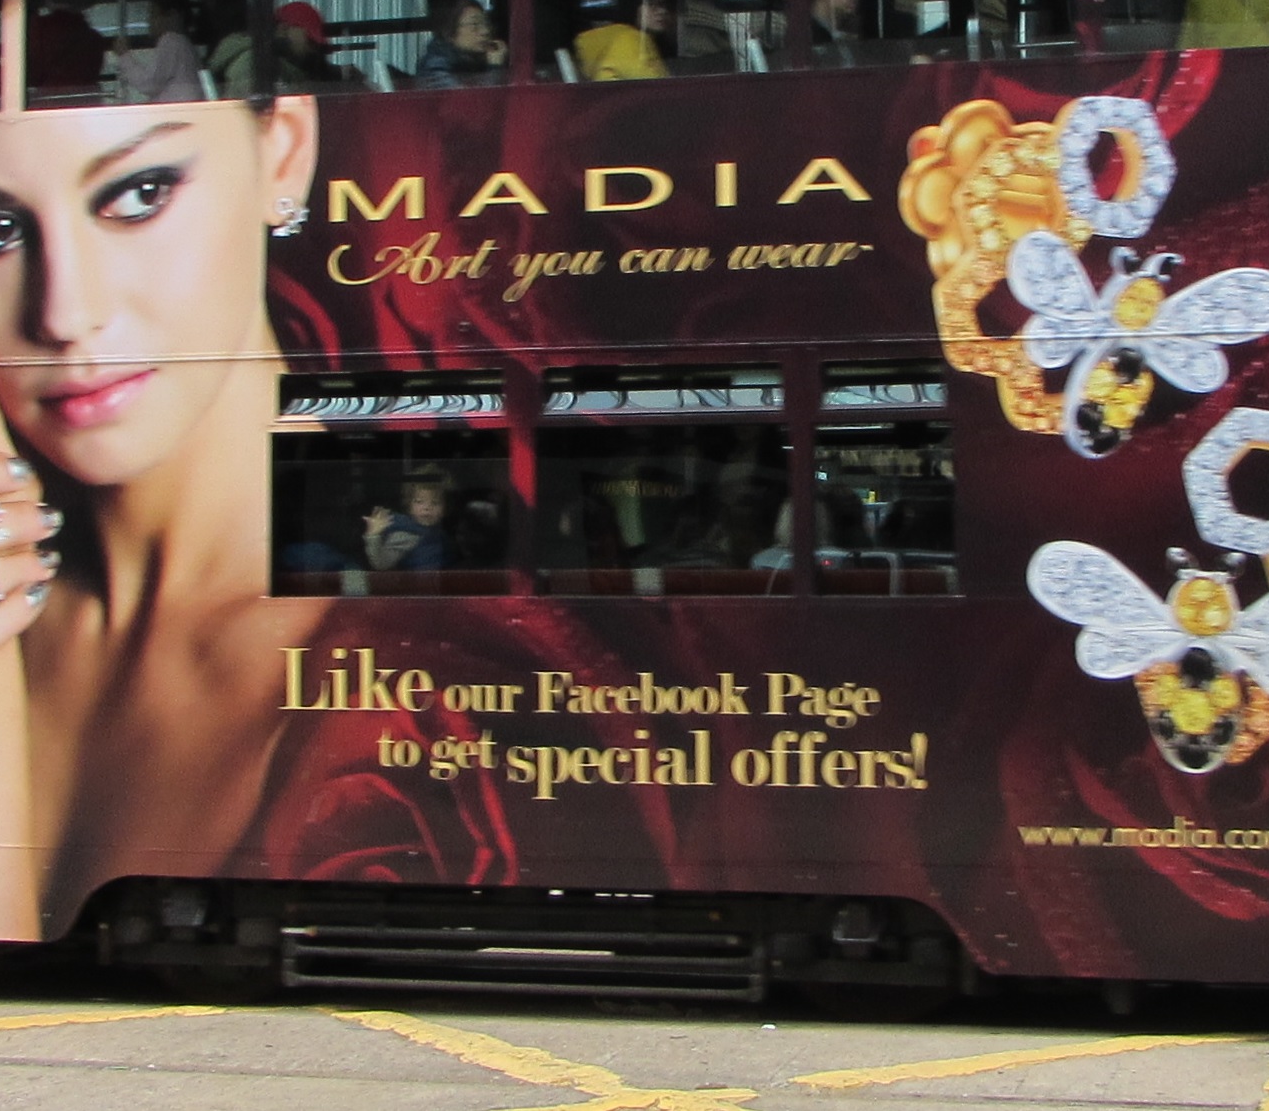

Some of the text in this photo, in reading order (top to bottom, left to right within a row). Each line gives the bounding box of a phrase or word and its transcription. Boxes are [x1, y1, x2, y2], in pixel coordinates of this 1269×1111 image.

[328, 157, 873, 223] MADIA
[327, 231, 499, 286] Art
[501, 244, 606, 303] you
[618, 241, 715, 275] can
[277, 647, 882, 729] Like our Facebook Page
[377, 728, 929, 801] to get special offers!
